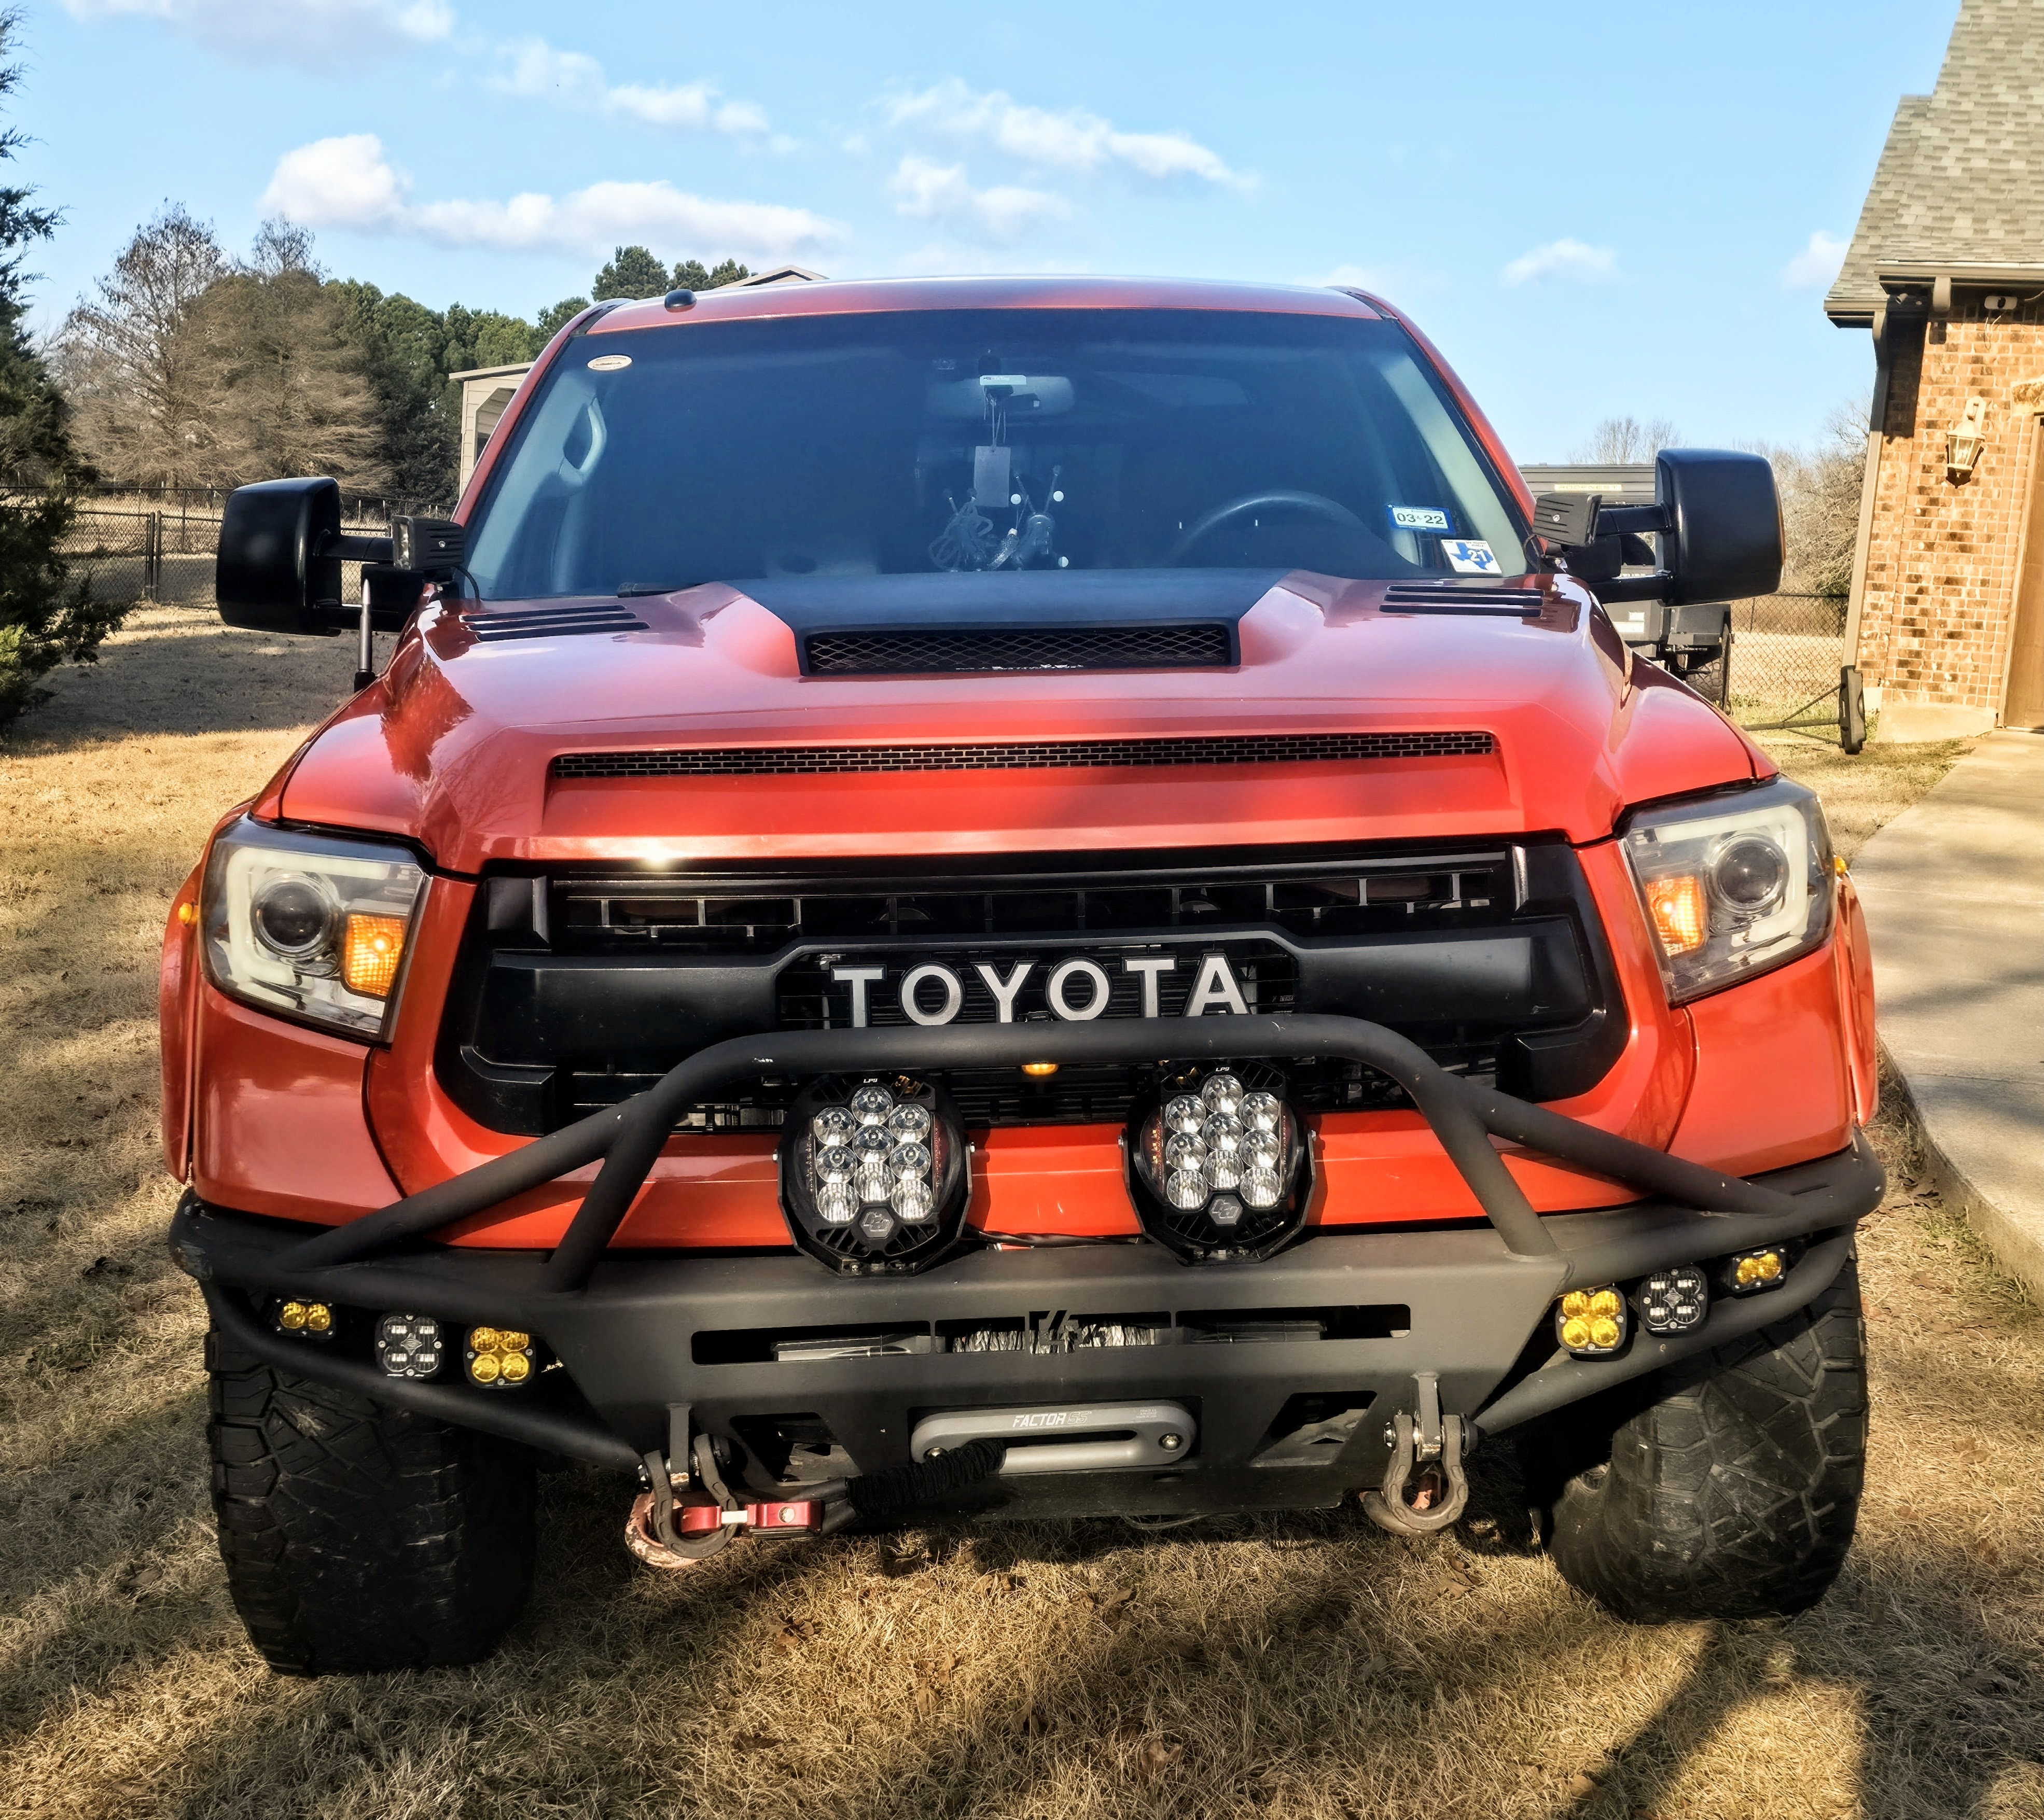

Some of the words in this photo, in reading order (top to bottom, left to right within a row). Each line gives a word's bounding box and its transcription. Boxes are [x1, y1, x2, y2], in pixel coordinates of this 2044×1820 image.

[1397, 513, 1416, 523] 03
[1424, 515, 1444, 524] 22
[1467, 550, 1487, 562] 21
[831, 952, 1252, 1029] TOYOTA
[1012, 1412, 1067, 1427] FACTOR
